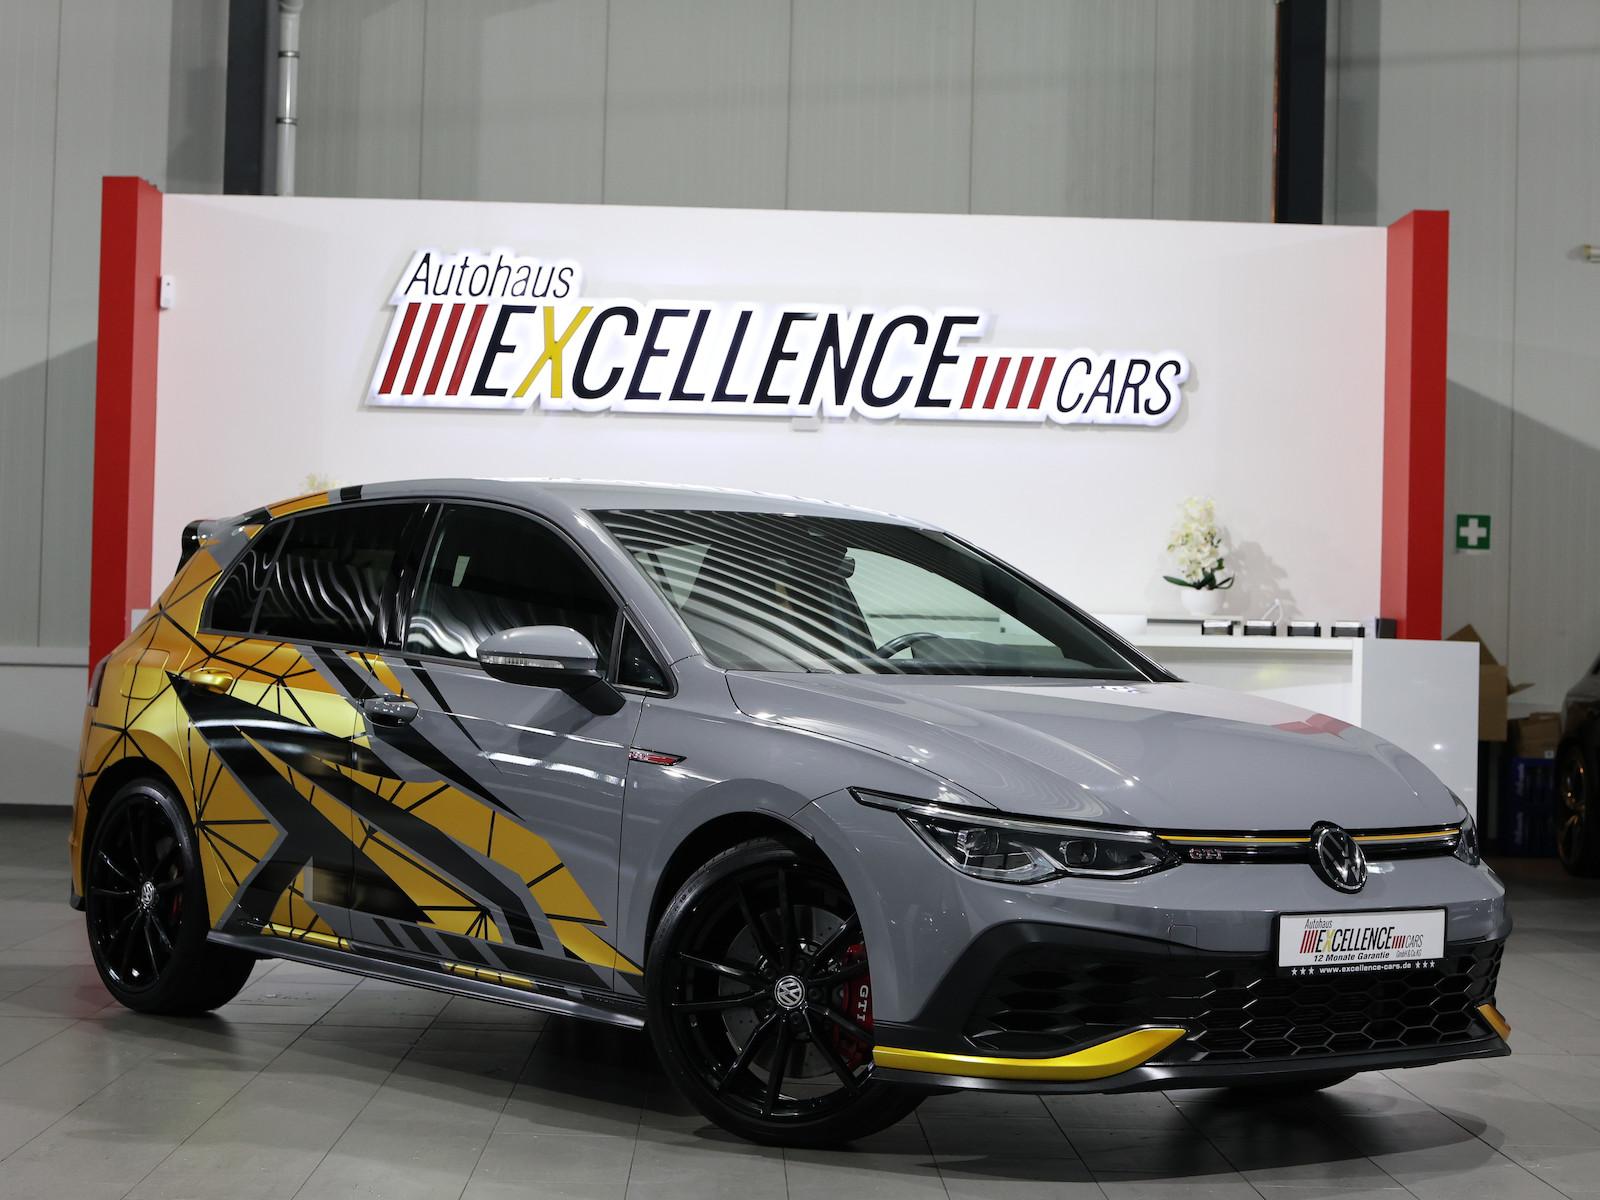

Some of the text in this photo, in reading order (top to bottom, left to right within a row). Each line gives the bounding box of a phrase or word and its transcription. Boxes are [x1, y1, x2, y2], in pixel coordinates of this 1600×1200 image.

[404, 252, 574, 298] Autohaus
[470, 304, 1182, 416] EXCELLENCE CARS
[1304, 918, 1333, 929] Autohaus
[1315, 926, 1424, 953] EXCELLENCE CARS
[1314, 954, 1323, 962] 12
[1325, 953, 1355, 962] Monate
[1357, 952, 1390, 961] Garantie
[1319, 962, 1412, 974] www.excellence-cars.de
[856, 984, 869, 1022] GTI
